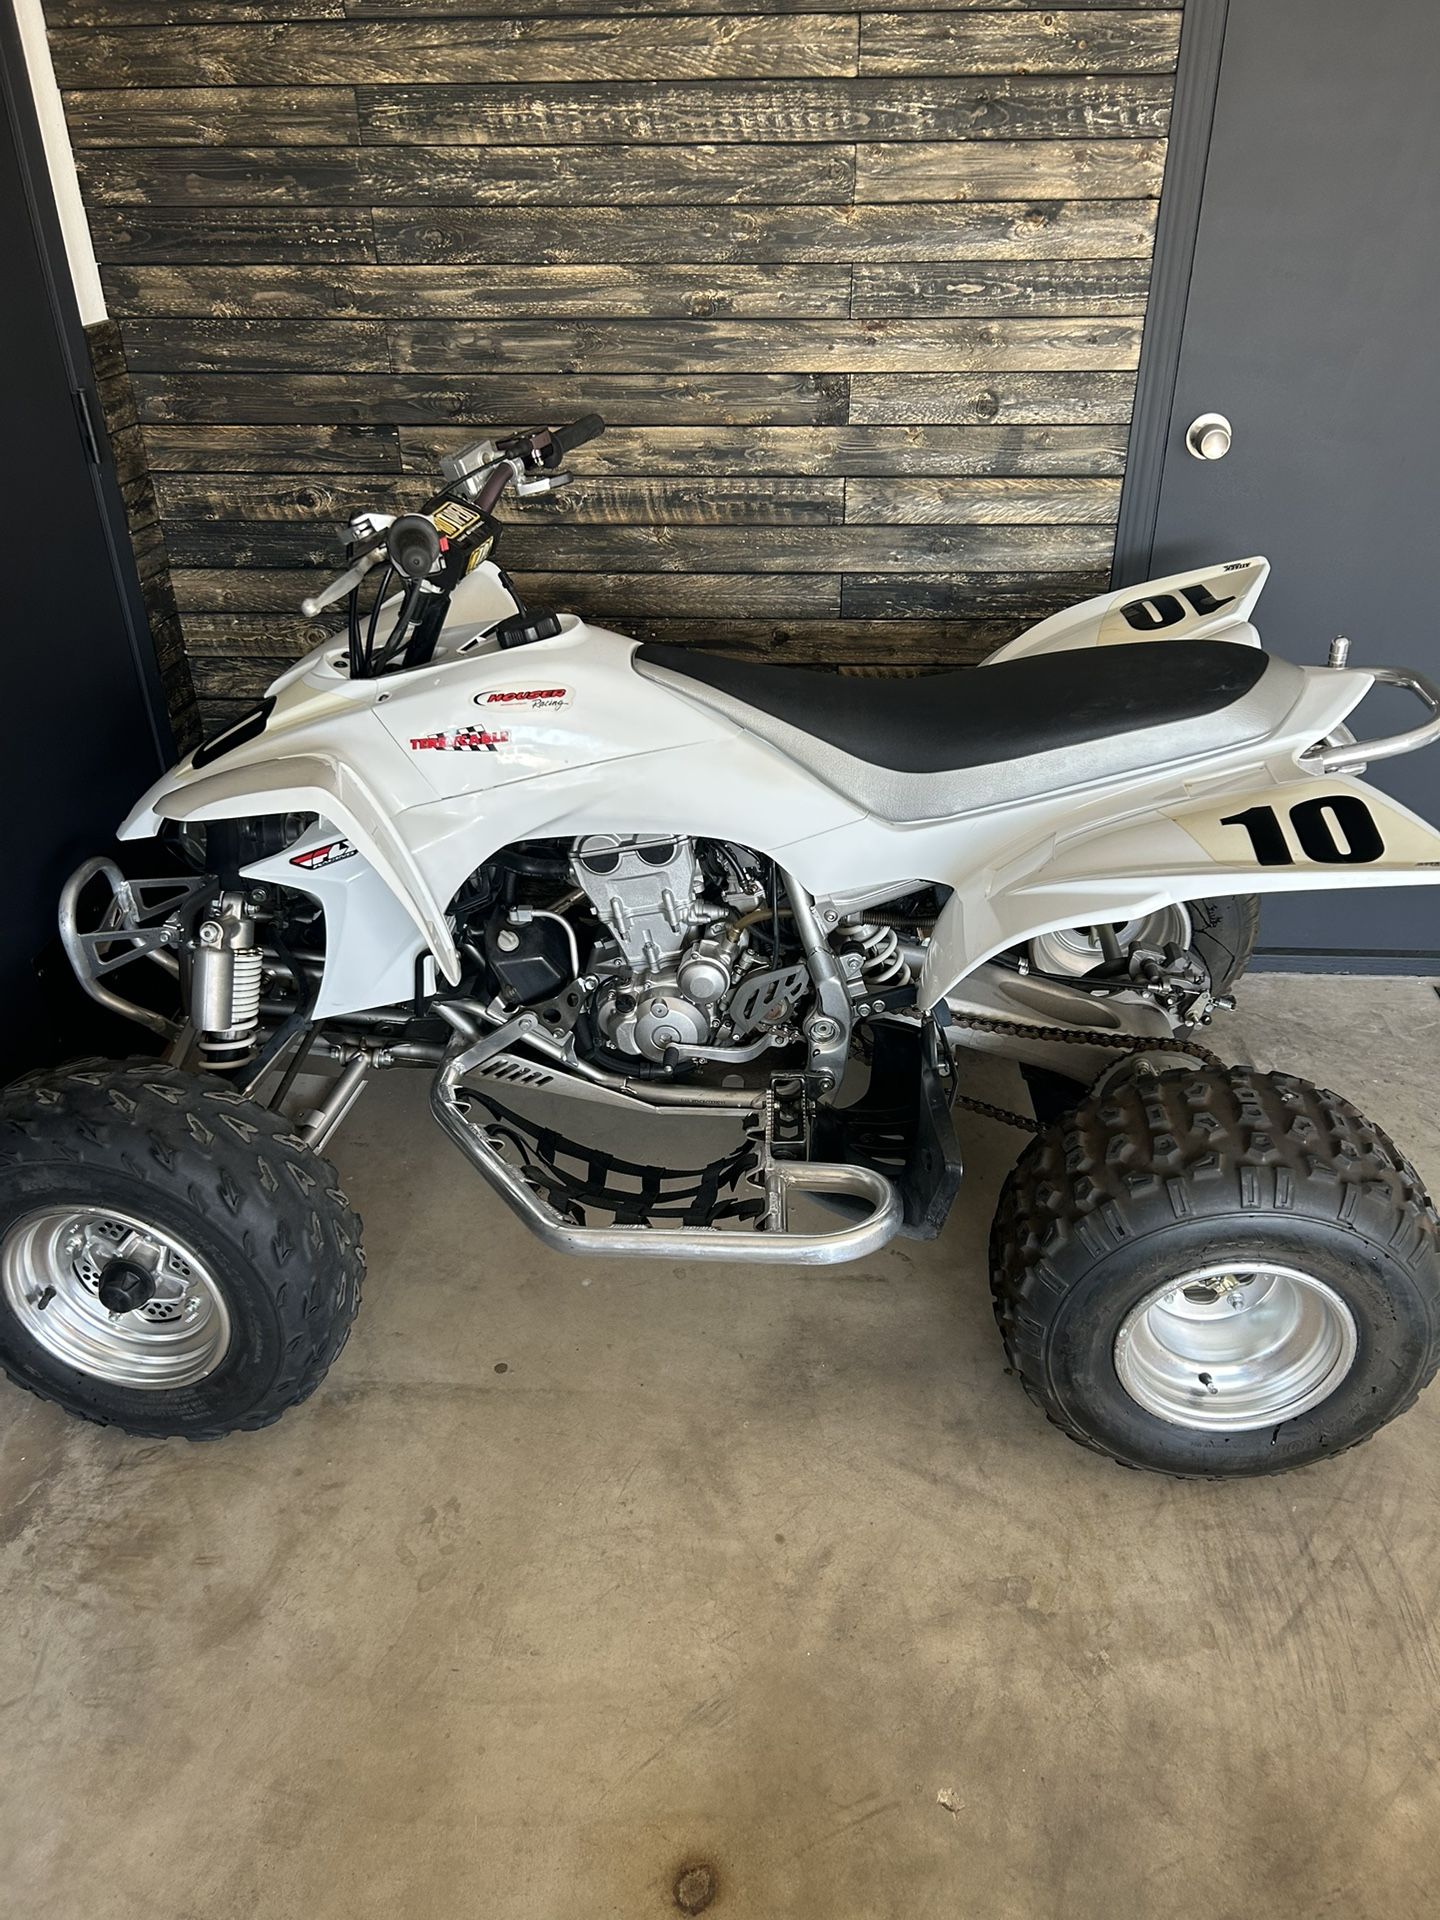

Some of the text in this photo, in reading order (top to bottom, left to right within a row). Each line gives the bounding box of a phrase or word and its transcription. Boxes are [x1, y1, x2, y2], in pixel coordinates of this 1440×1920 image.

[1120, 584, 1237, 631] 10
[487, 689, 567, 703] HOUSER
[532, 699, 569, 711] Racing
[1219, 795, 1386, 867] 10
